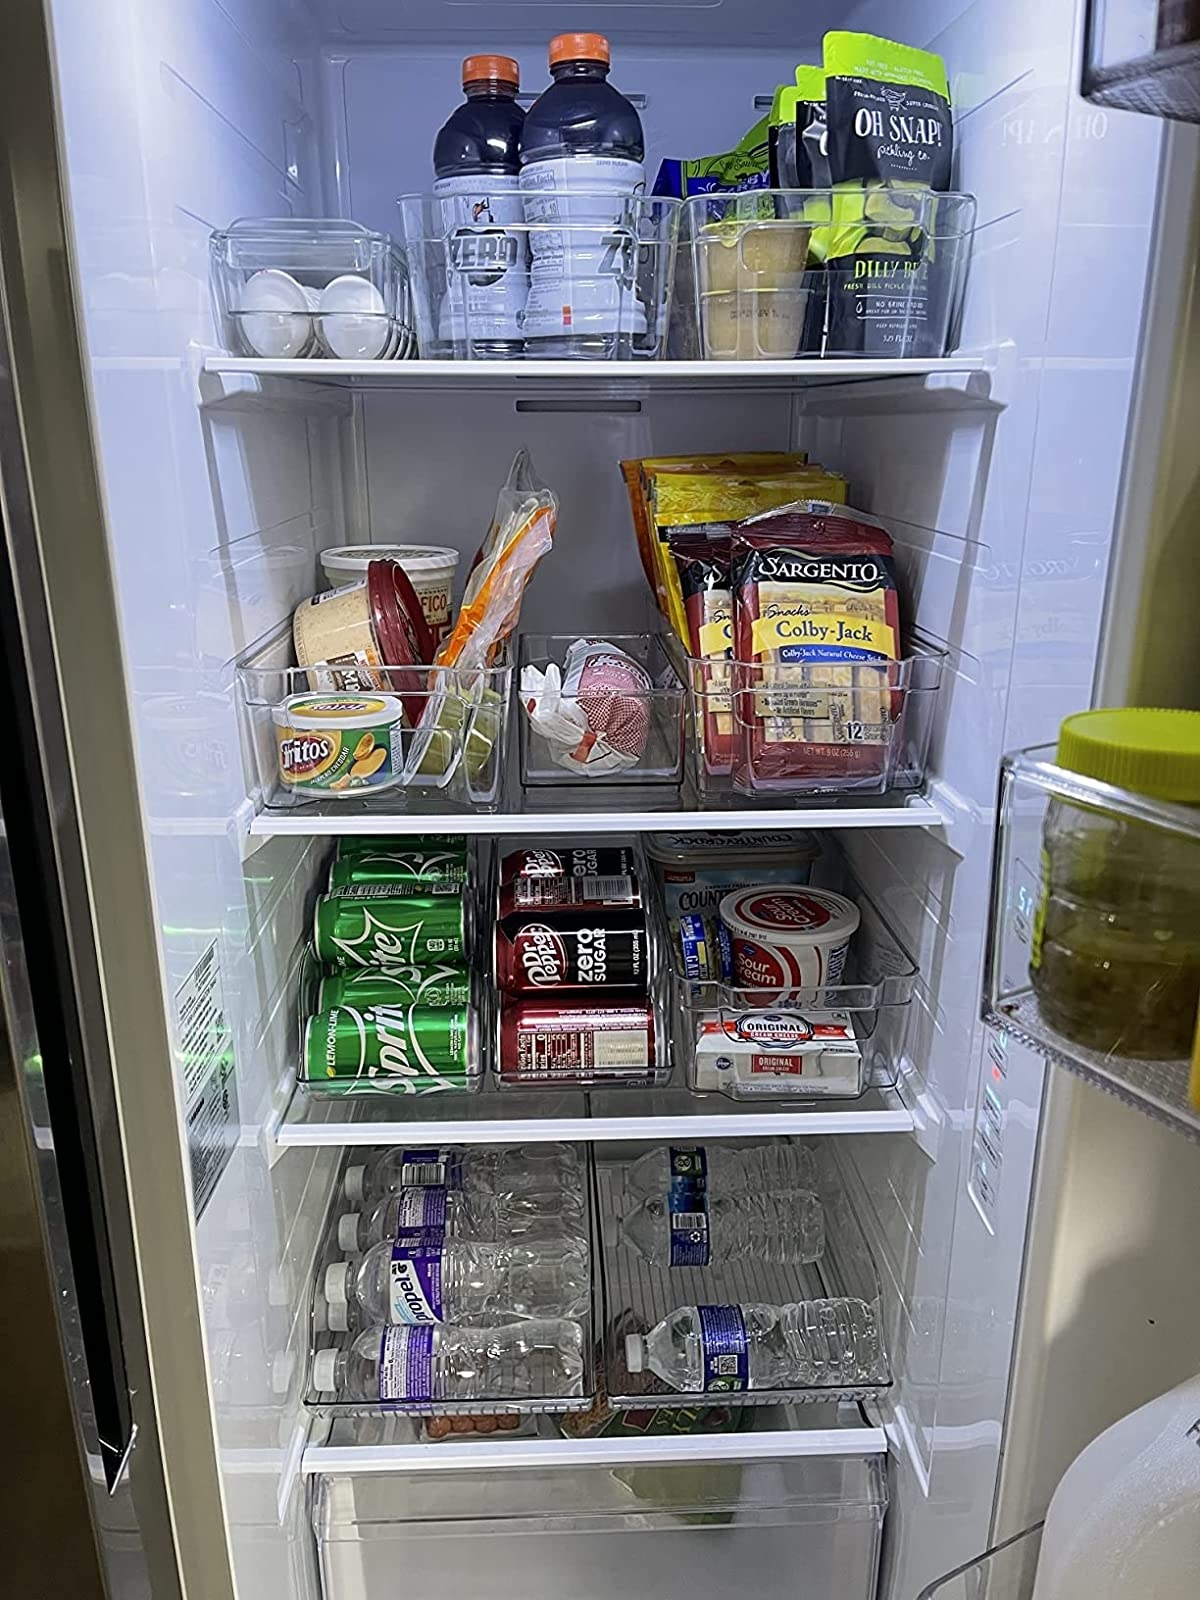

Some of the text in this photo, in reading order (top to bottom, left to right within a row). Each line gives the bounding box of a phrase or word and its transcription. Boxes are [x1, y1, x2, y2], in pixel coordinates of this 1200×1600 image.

[854, 108, 943, 147] OH SNAP!
[877, 144, 915, 166] pickling
[451, 235, 519, 269] ZERO
[854, 260, 900, 279] DILLY
[758, 557, 879, 582] SARGENTO
[767, 604, 811, 619] Snacks
[776, 620, 873, 642] Colby-Jack
[782, 649, 816, 659] Colby-Jack
[847, 722, 863, 740] 12
[573, 850, 587, 876] ero
[587, 850, 598, 876] UGAR
[761, 903, 792, 921] Sour
[771, 898, 811, 924] Cream
[522, 941, 542, 967] Dr
[527, 927, 562, 986] Pepper
[577, 928, 594, 982] zero
[593, 927, 607, 982] SUGAR
[737, 952, 770, 973] Sour
[326, 1009, 339, 1066] LEMON-LIME
[747, 1022, 803, 1033] ORIGINAL
[362, 1003, 420, 1095] Sprit
[758, 1057, 793, 1067] ORIGINAL
[394, 1276, 434, 1321] propel
